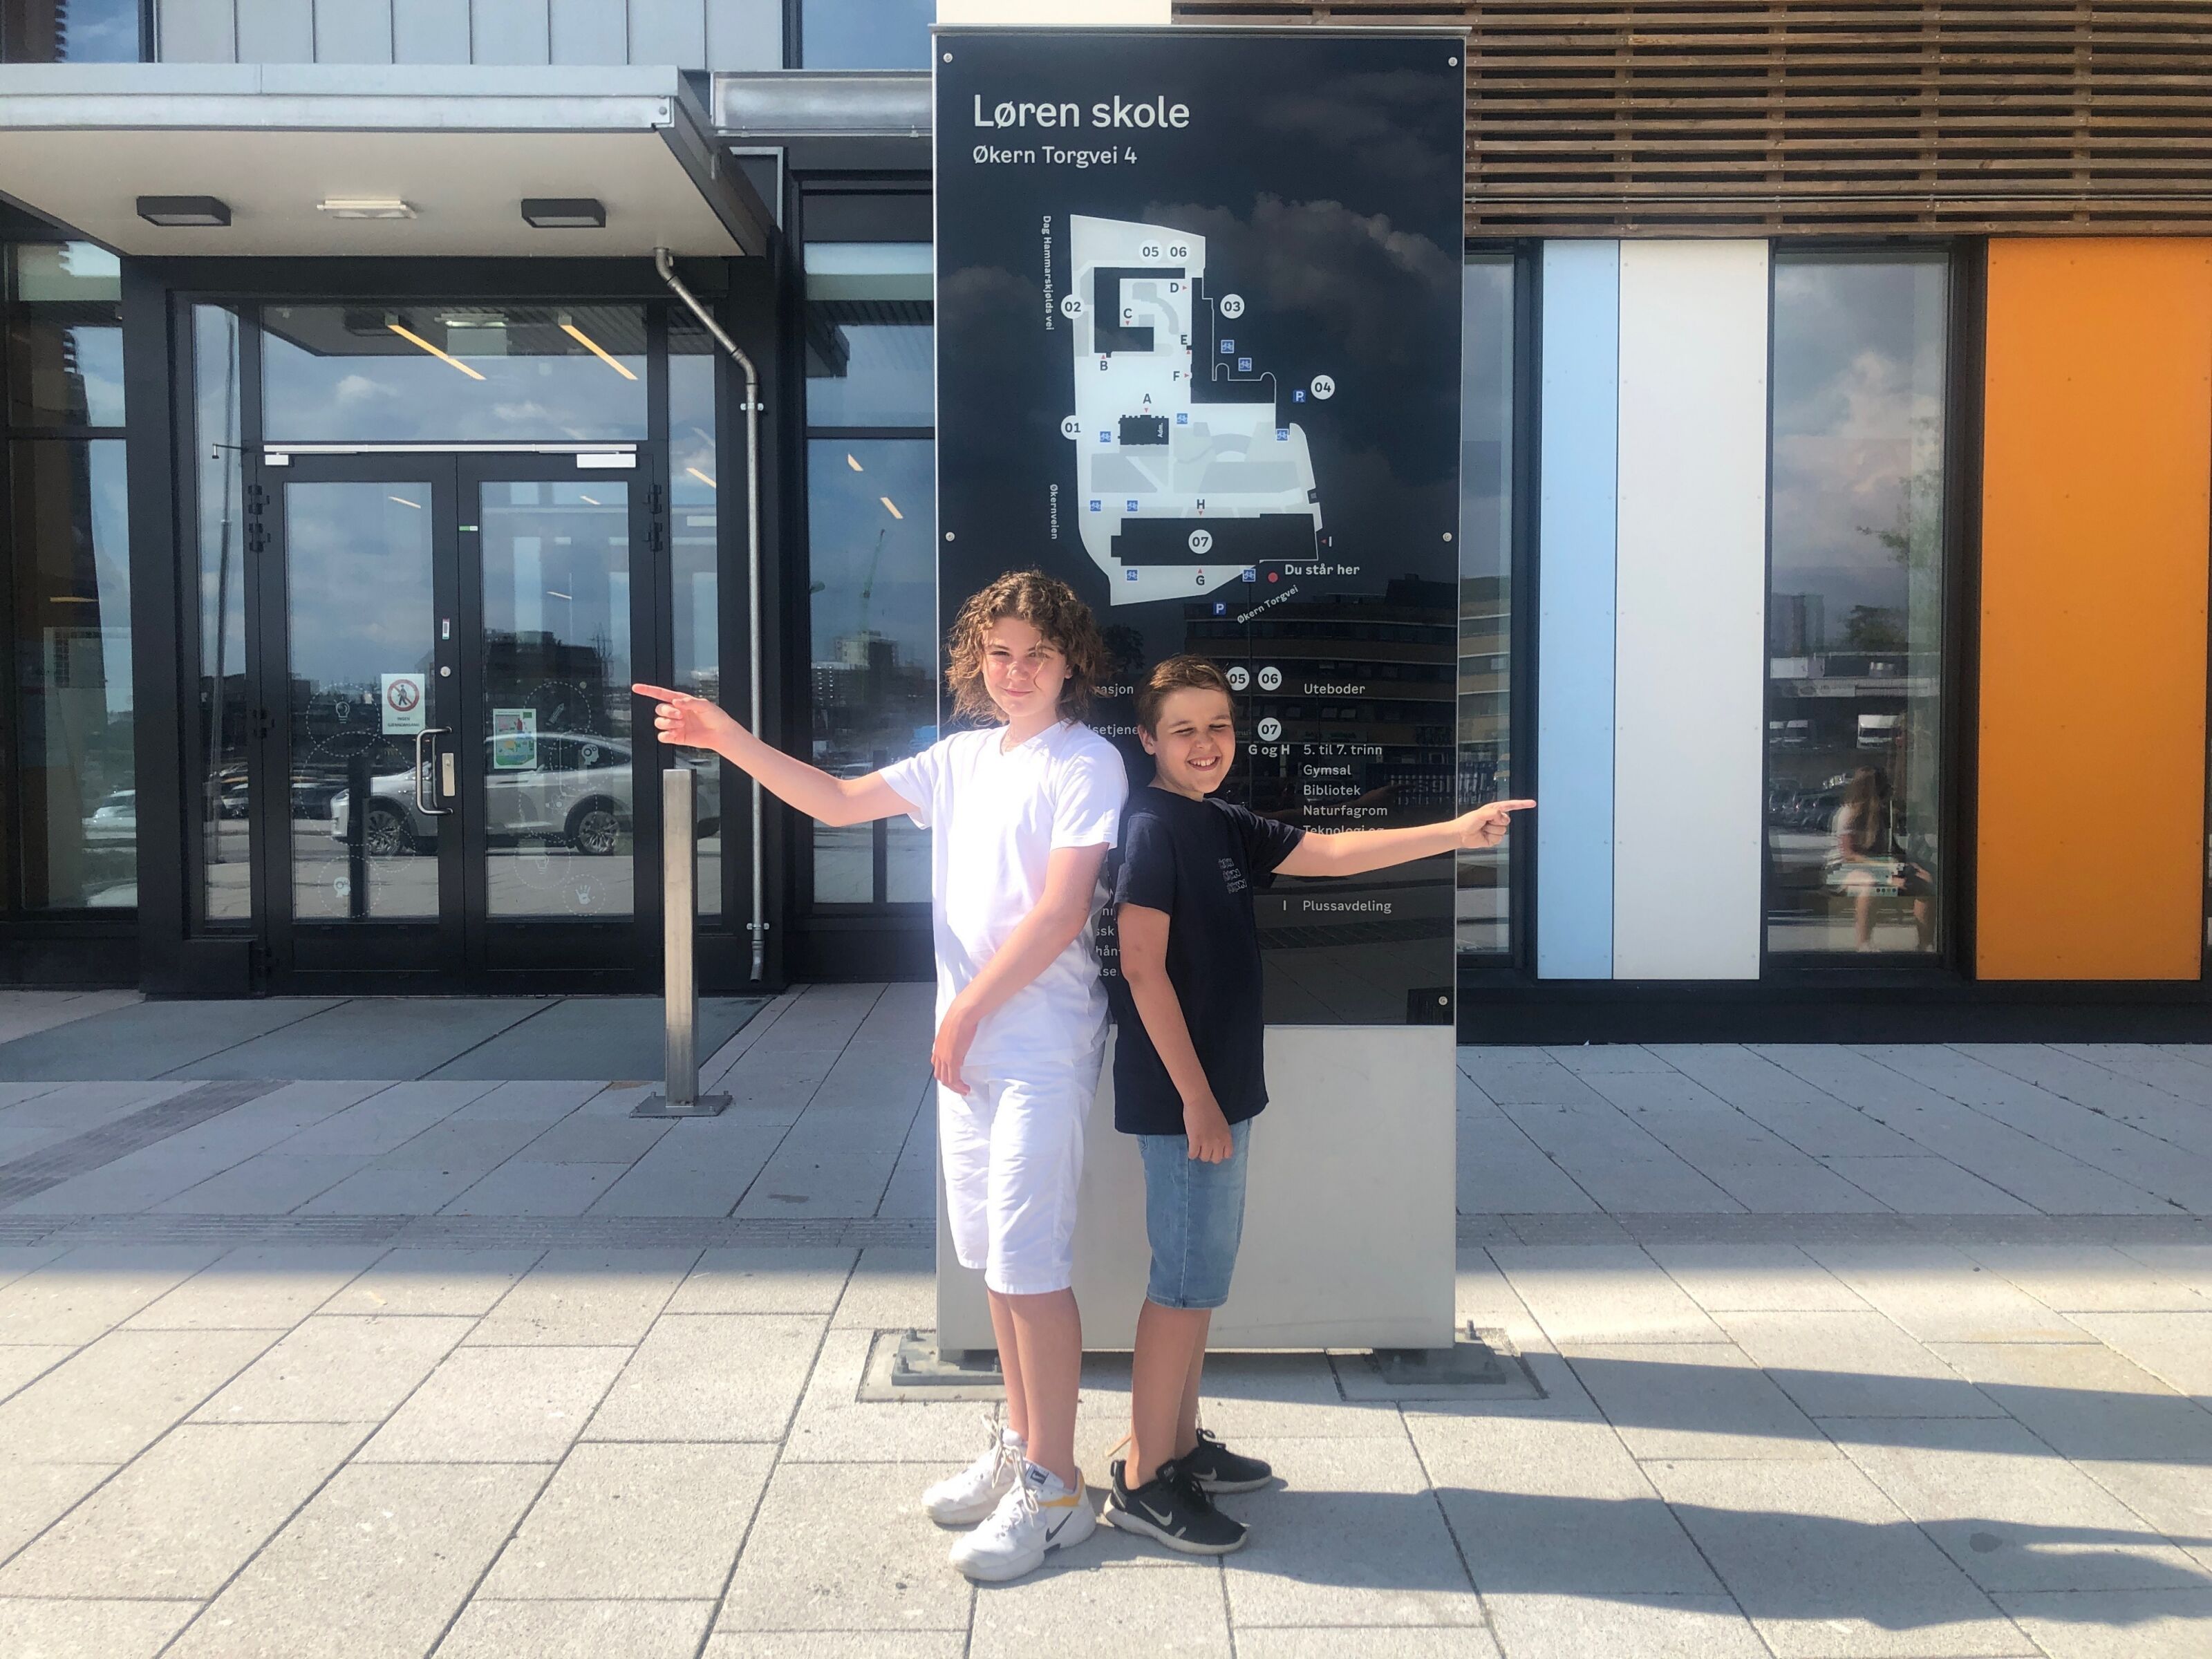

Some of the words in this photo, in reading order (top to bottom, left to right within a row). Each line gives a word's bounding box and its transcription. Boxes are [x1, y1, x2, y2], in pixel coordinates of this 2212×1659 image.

[974, 94, 1080, 129] Løren
[1091, 95, 1190, 128] skole
[973, 144, 1035, 165] Økern
[1041, 145, 1118, 169] Torgvei
[1124, 147, 1138, 165] 4
[1042, 216, 1051, 235] Dag
[1142, 246, 1159, 257] 05
[1170, 246, 1187, 257] 06
[1042, 236, 1054, 314] Hammarskjølds
[1170, 282, 1179, 293] D
[1065, 301, 1082, 312] 02
[1224, 301, 1241, 312] 03
[1123, 308, 1132, 319] C
[1046, 315, 1055, 330] vei
[1180, 334, 1188, 346] E
[1100, 360, 1108, 371] B
[1173, 371, 1181, 382] F
[1314, 382, 1332, 393] 04
[1143, 393, 1152, 404] A
[1065, 422, 1081, 433] 01
[1197, 499, 1206, 510] H
[1049, 484, 1060, 540] Økernveien
[1192, 536, 1209, 547] 07
[1285, 564, 1302, 575] Du
[1305, 563, 1333, 575] står
[1337, 563, 1360, 575] her
[1195, 574, 1205, 586] G
[1237, 606, 1264, 624] Økern
[1264, 584, 1299, 609] Torgvei
[1229, 673, 1246, 684] 05
[1262, 673, 1279, 684] 06
[1304, 683, 1366, 694] Uteboder
[1261, 724, 1278, 735] 07
[1248, 744, 1257, 755] G
[1261, 747, 1278, 758] og
[1281, 744, 1290, 755] H
[1304, 744, 1315, 755] 5.
[1318, 744, 1333, 755] til
[1336, 744, 1347, 755] 7.
[1350, 744, 1382, 756] trinn
[1303, 764, 1351, 778] Gymsal
[1303, 784, 1361, 796] Bibliotek
[1303, 805, 1387, 818] Naturfagrom
[1303, 900, 1392, 915] Plussavdeling
